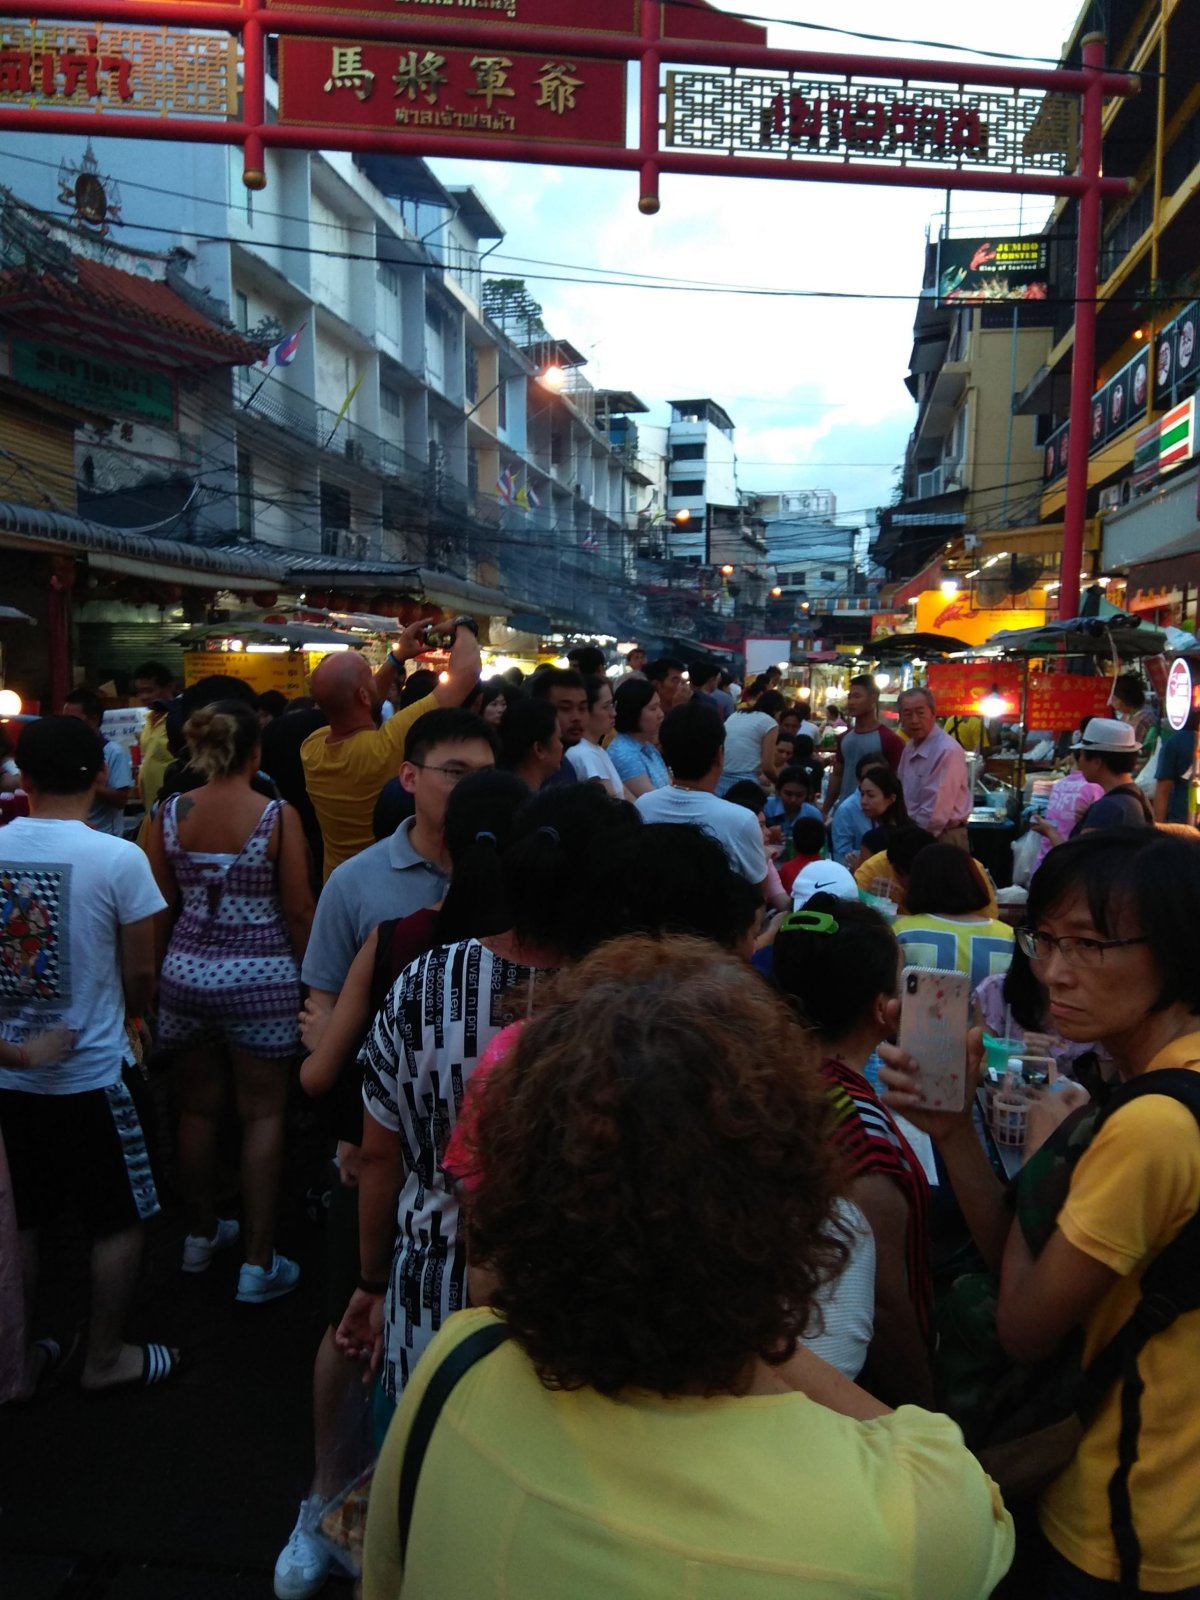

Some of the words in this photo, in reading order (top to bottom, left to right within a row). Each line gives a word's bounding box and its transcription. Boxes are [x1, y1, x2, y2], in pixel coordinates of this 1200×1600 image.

[323, 46, 585, 115] 馬將軍爺
[996, 242, 1039, 252] JUMBO
[996, 252, 1038, 260] LOBSTER
[425, 957, 437, 1021] discovery
[450, 988, 460, 1020] new
